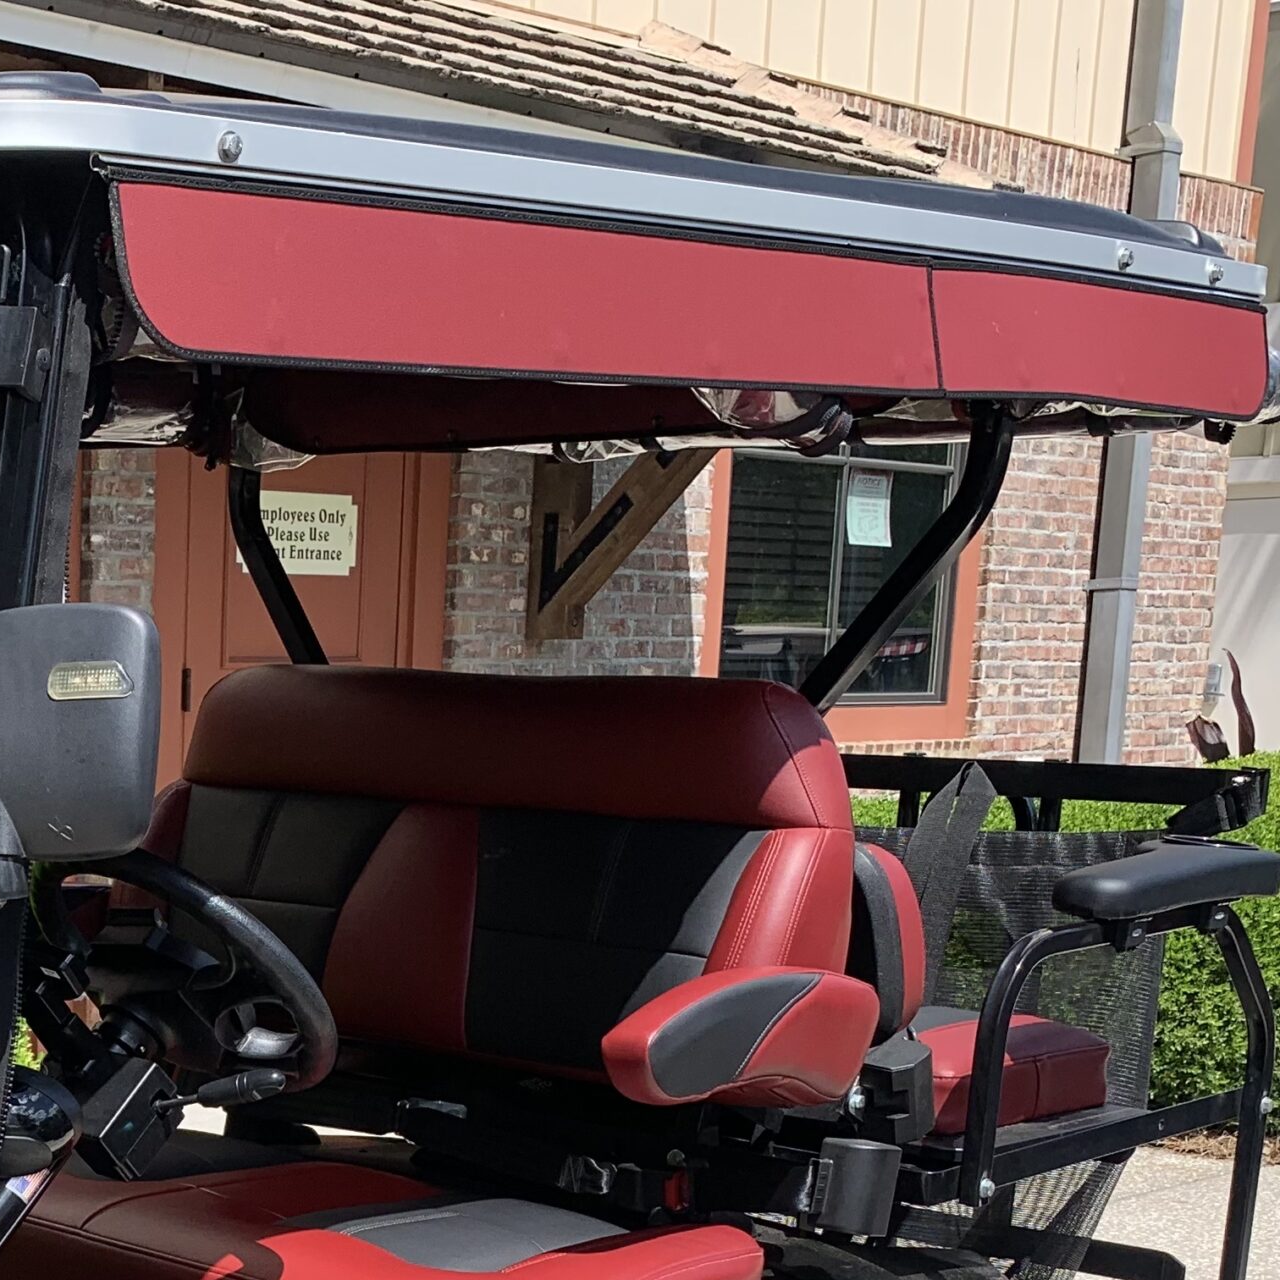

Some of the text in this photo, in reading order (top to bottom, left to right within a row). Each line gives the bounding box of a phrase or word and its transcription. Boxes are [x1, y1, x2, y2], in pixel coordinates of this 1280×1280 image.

[260, 507, 346, 526] mployees Only
[267, 526, 330, 542] Please Use
[289, 545, 342, 561] Entrance
